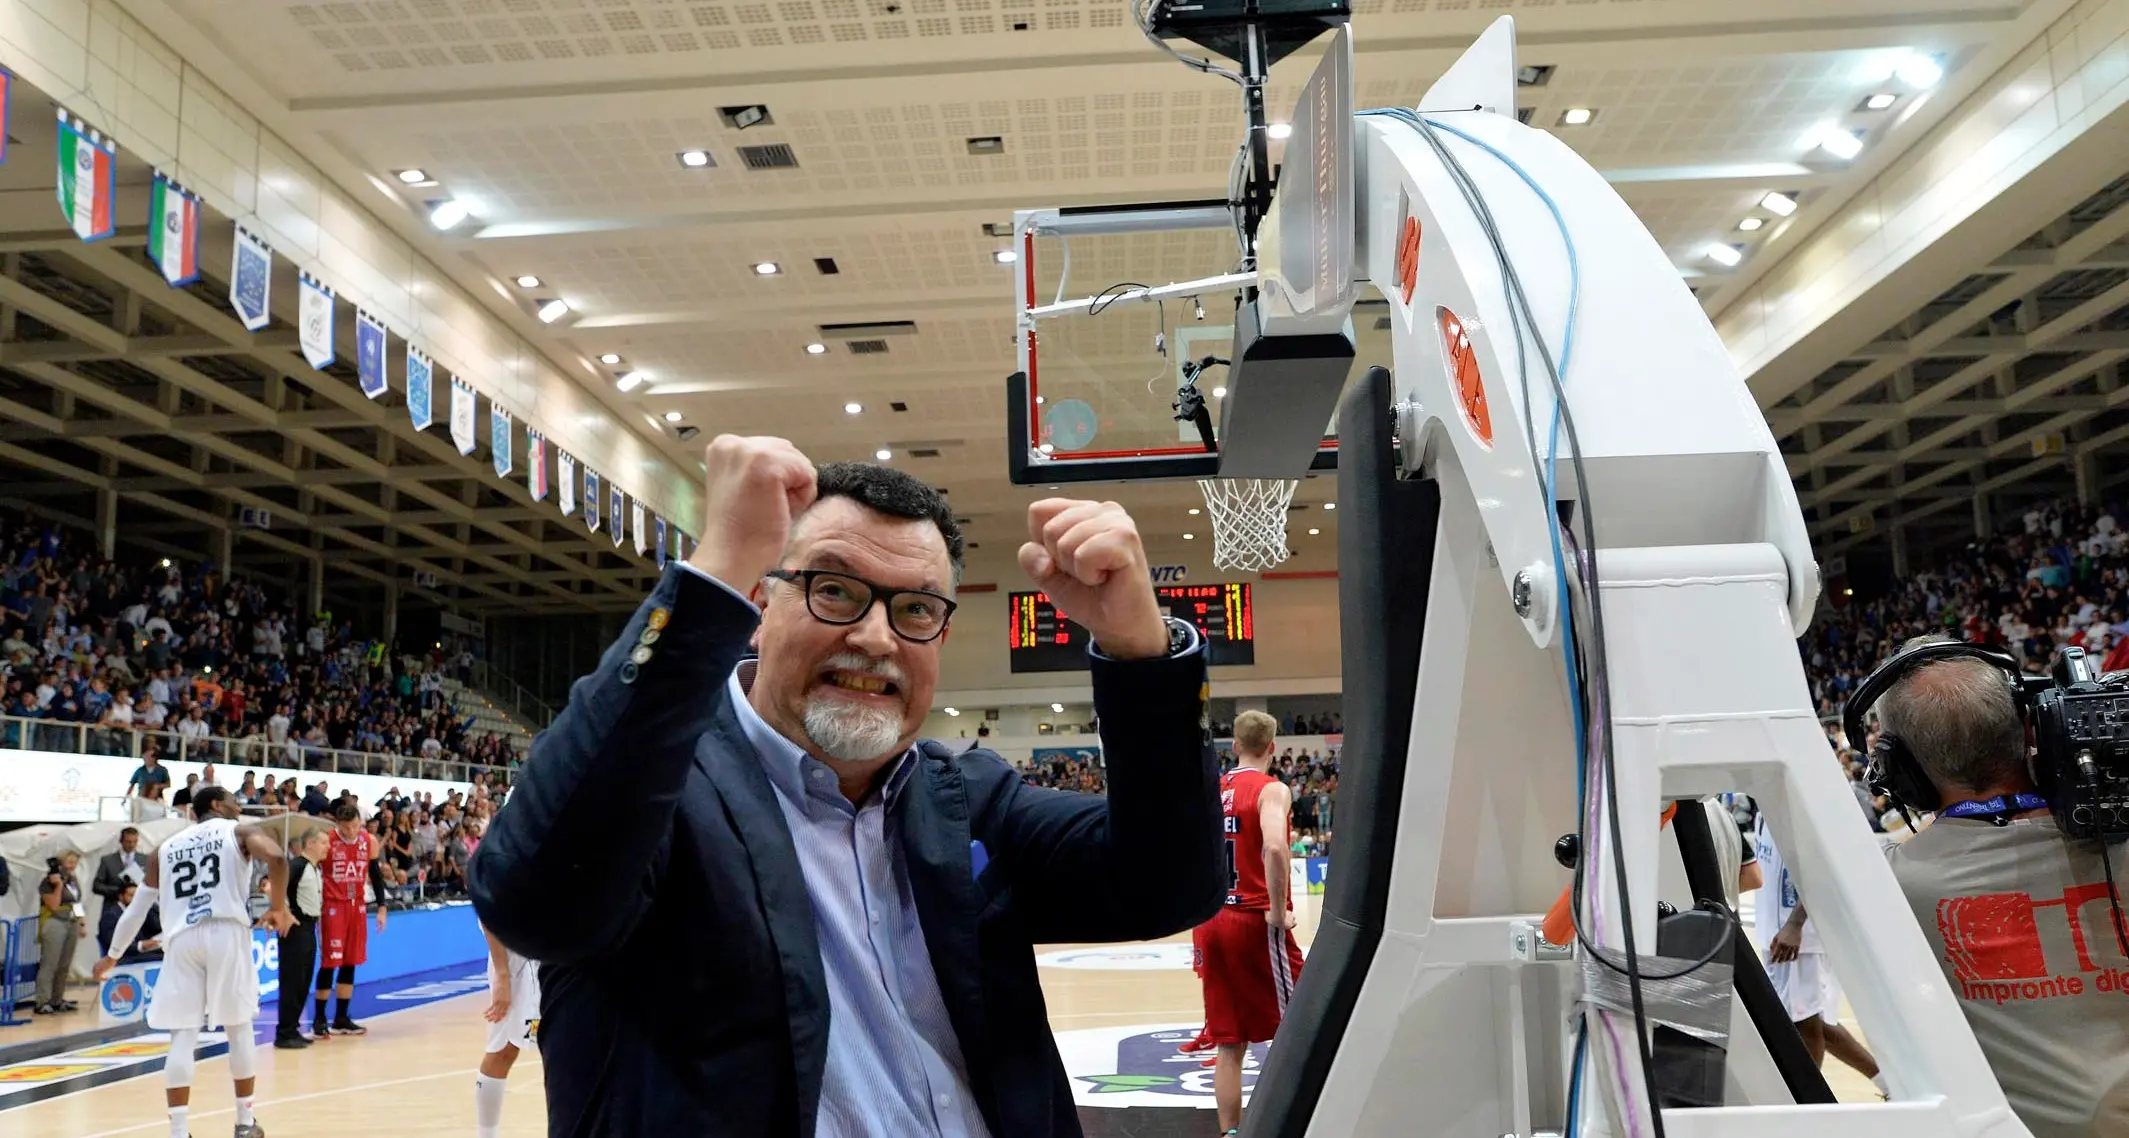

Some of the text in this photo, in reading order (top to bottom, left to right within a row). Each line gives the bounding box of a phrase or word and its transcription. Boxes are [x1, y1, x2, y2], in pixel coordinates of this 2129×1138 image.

[167, 839, 224, 864] SUTTON
[172, 853, 221, 899] 23
[1961, 973, 2084, 1006] impronte
